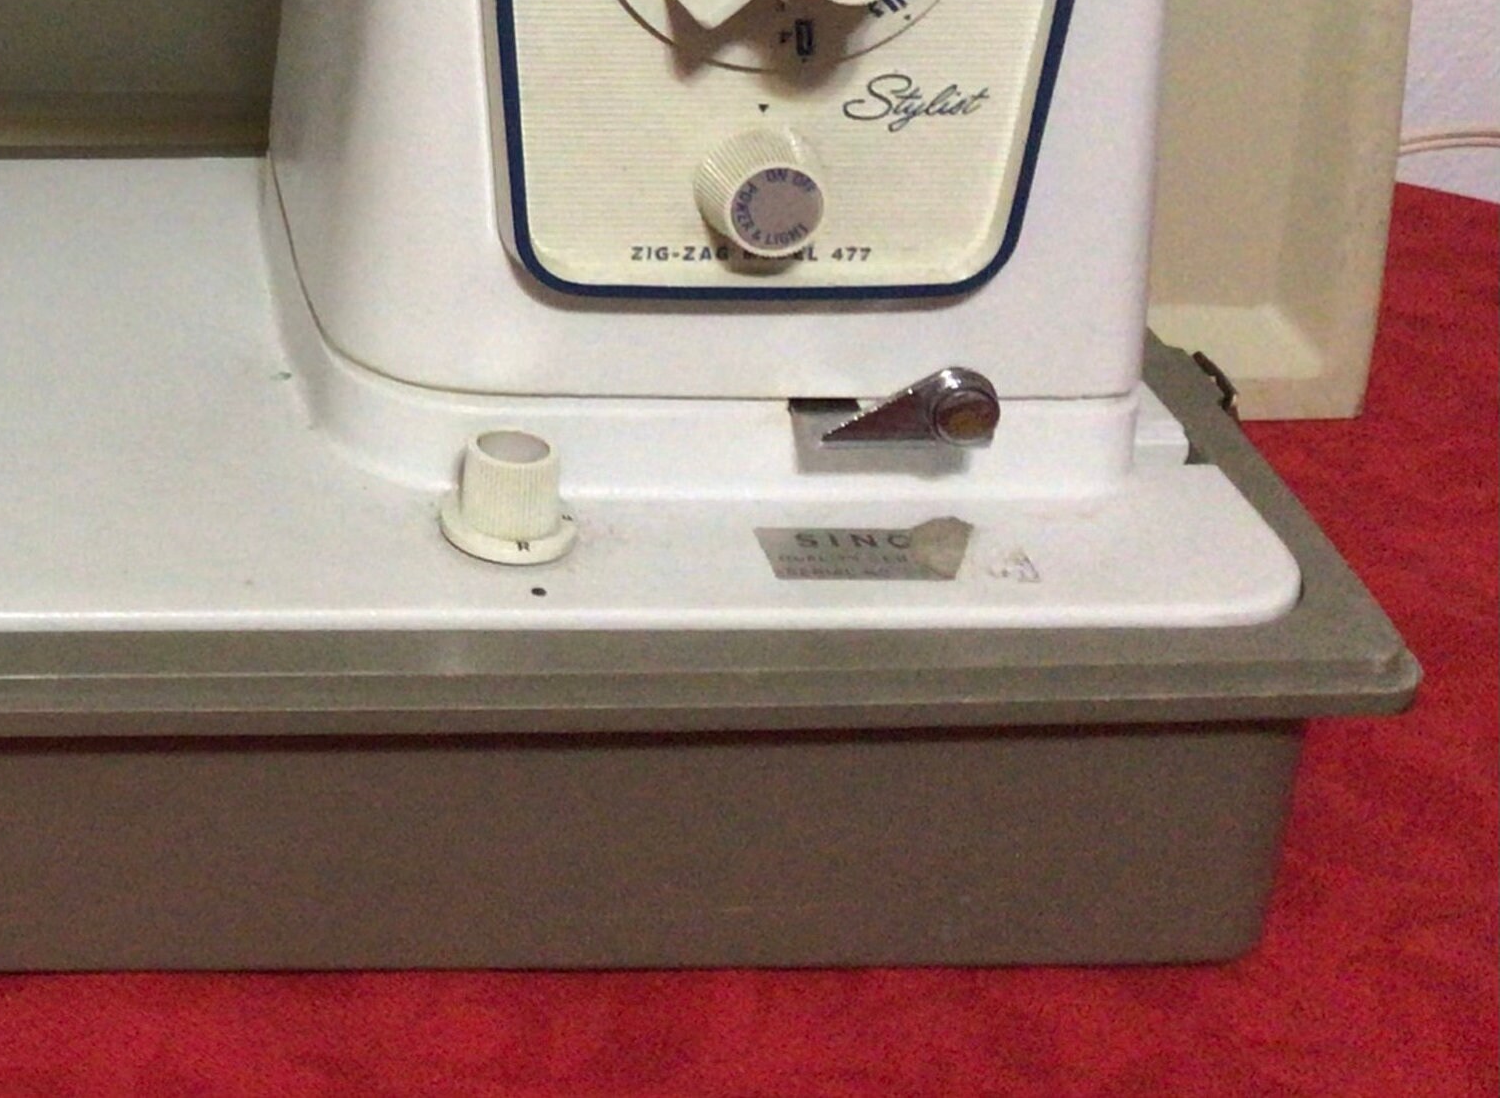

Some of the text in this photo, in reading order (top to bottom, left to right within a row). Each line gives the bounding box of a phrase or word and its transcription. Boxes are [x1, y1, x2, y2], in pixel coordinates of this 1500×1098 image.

[843, 73, 990, 133] Stylist
[765, 168, 789, 183] ON
[765, 222, 810, 247] LIGHT
[630, 246, 730, 262] ZIG-ZAG
[831, 247, 872, 262] 477
